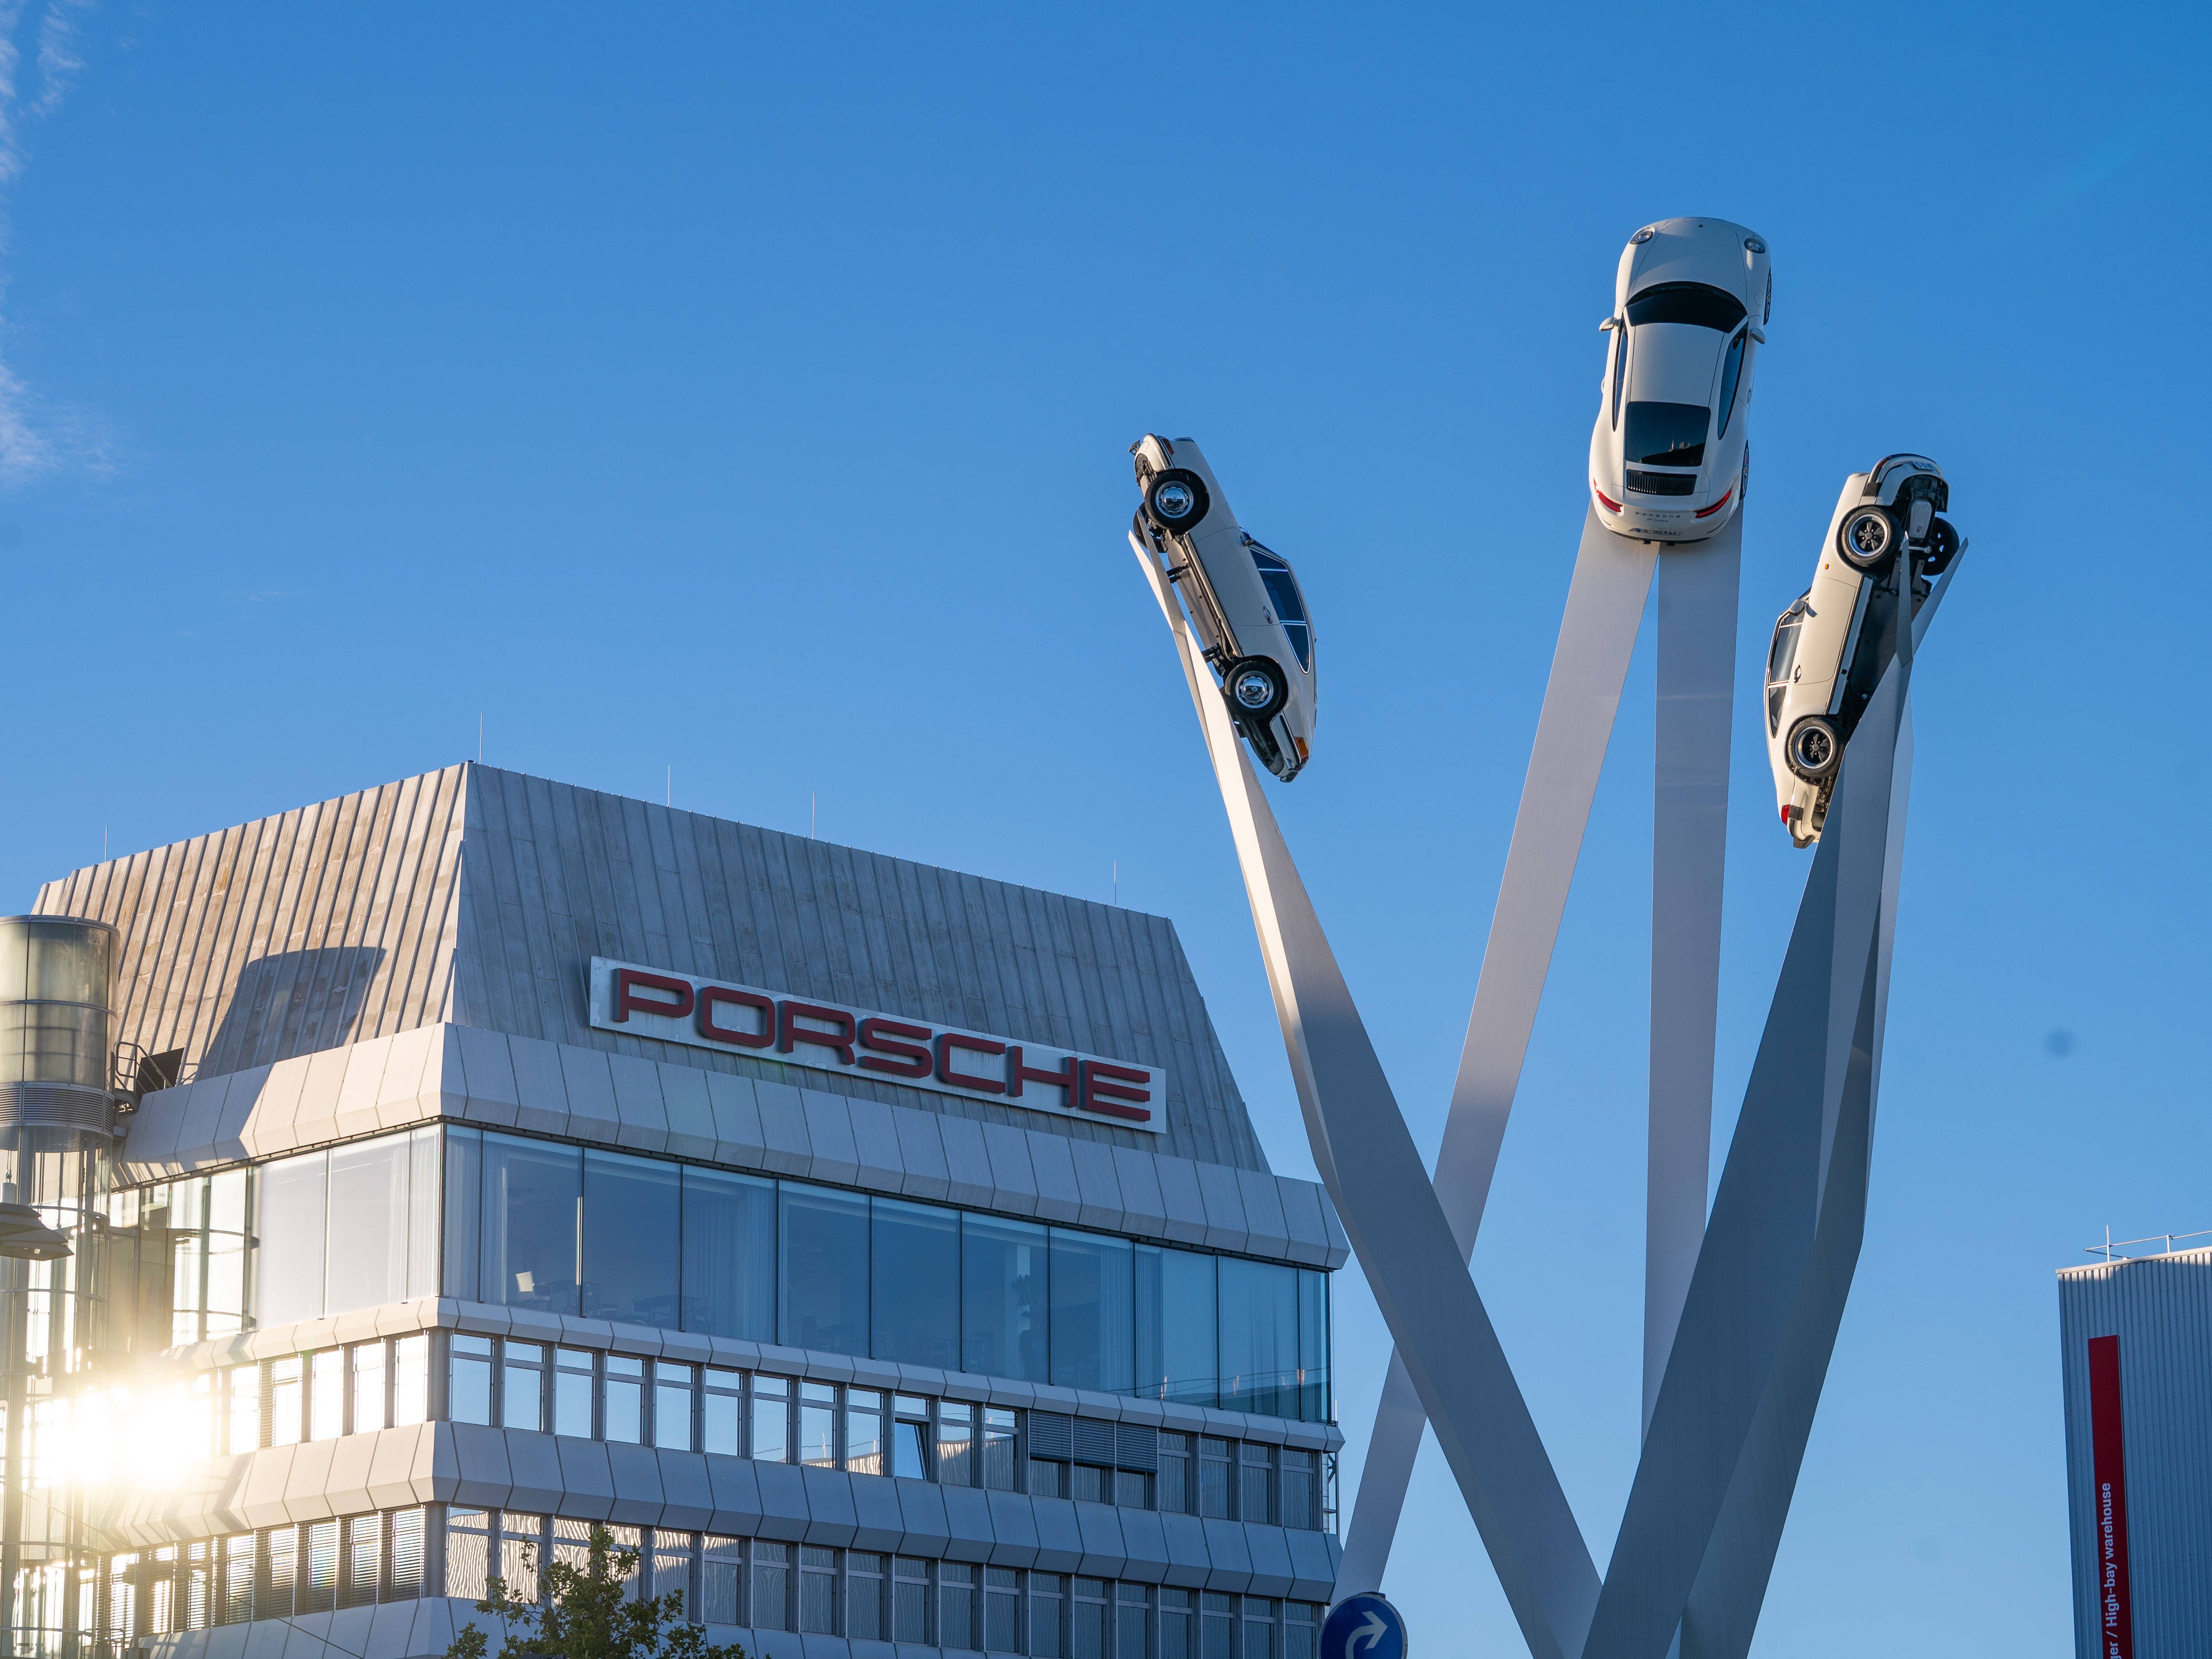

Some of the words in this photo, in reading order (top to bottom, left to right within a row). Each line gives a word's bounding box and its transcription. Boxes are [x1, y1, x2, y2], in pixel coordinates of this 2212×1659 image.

[613, 967, 1151, 1122] PORSCHE
[2101, 1483, 2114, 1560] warehouse
[2104, 1562, 2119, 1627] High-bay
